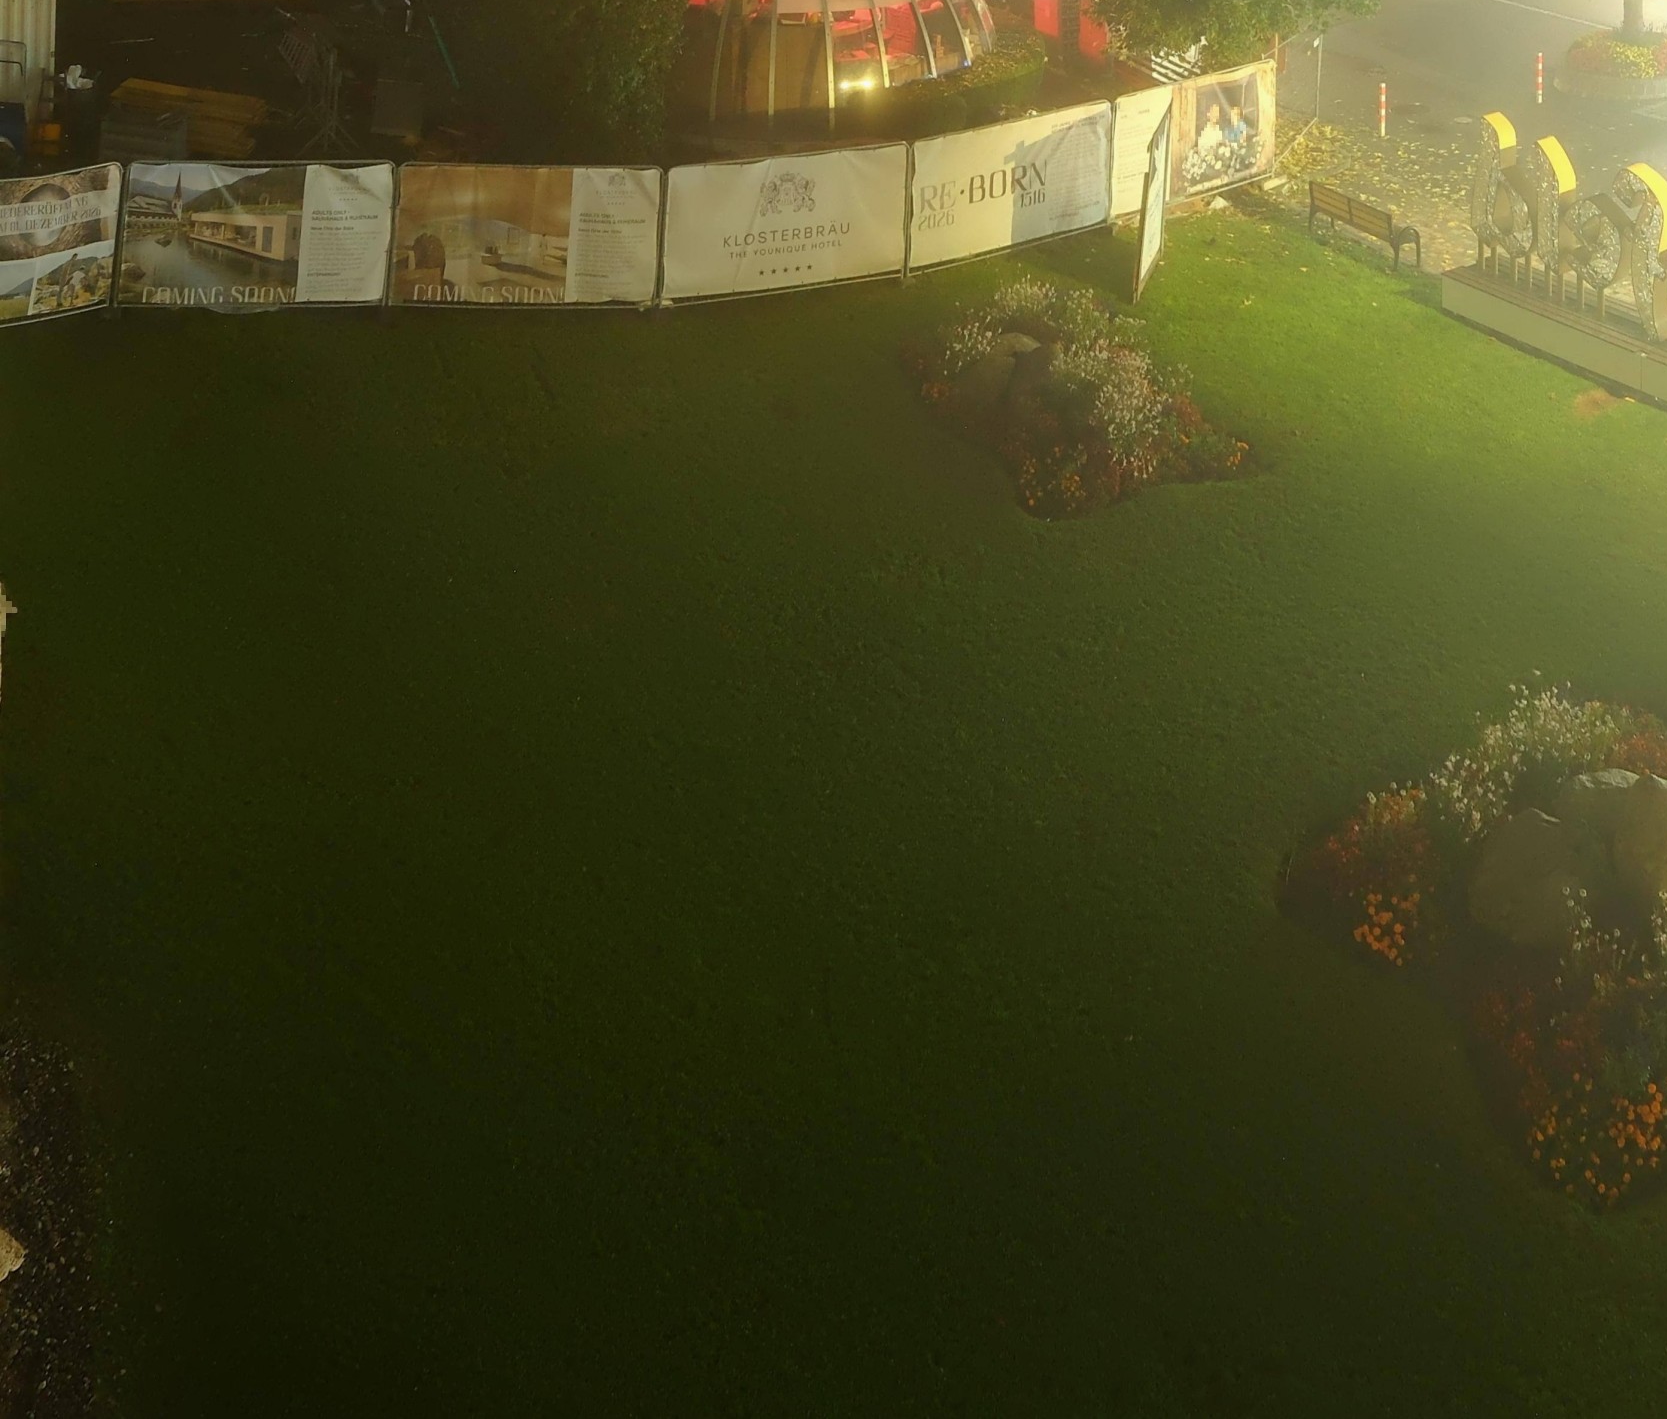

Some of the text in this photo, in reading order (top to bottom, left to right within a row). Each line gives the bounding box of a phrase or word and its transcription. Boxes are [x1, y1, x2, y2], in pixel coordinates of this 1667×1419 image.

[1020, 188, 1046, 210] 1516
[918, 208, 956, 231] 2026
[722, 220, 851, 249] KLOSTERBRÄU
[729, 239, 842, 260] THE YOUNIQUE HOTEL
[141, 285, 221, 305] COMING
